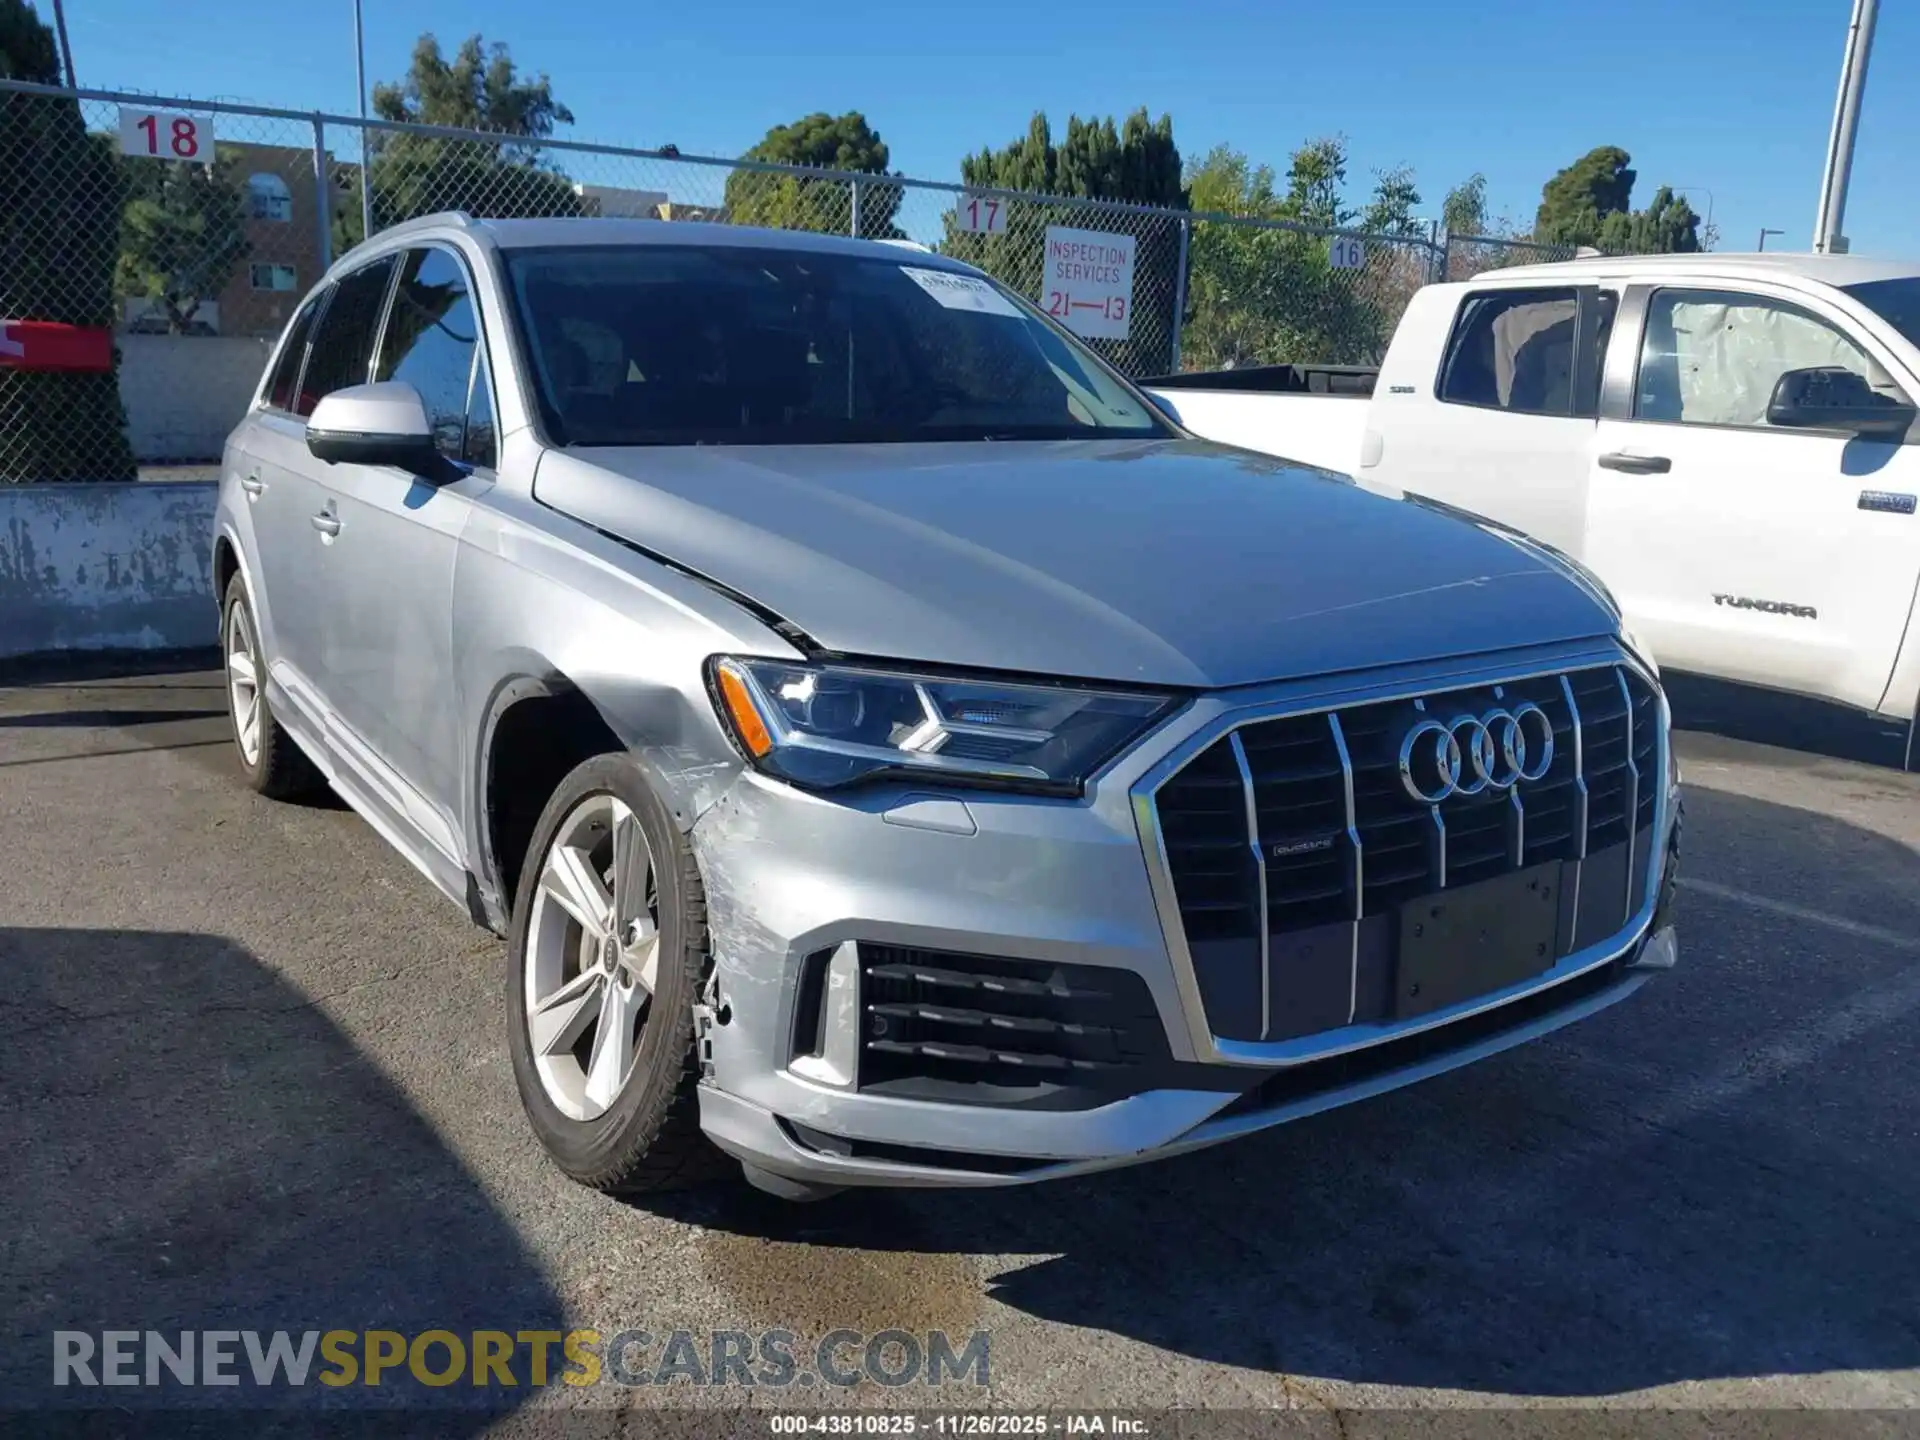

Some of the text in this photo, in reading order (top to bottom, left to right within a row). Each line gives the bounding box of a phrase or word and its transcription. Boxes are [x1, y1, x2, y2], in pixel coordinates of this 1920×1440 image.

[137, 114, 199, 158] 18
[967, 200, 999, 231] 17
[1049, 239, 1126, 265] INSPECTION
[1336, 241, 1360, 266] 16
[1056, 263, 1120, 284] SERVICES
[1711, 593, 1817, 620] TUNDRA
